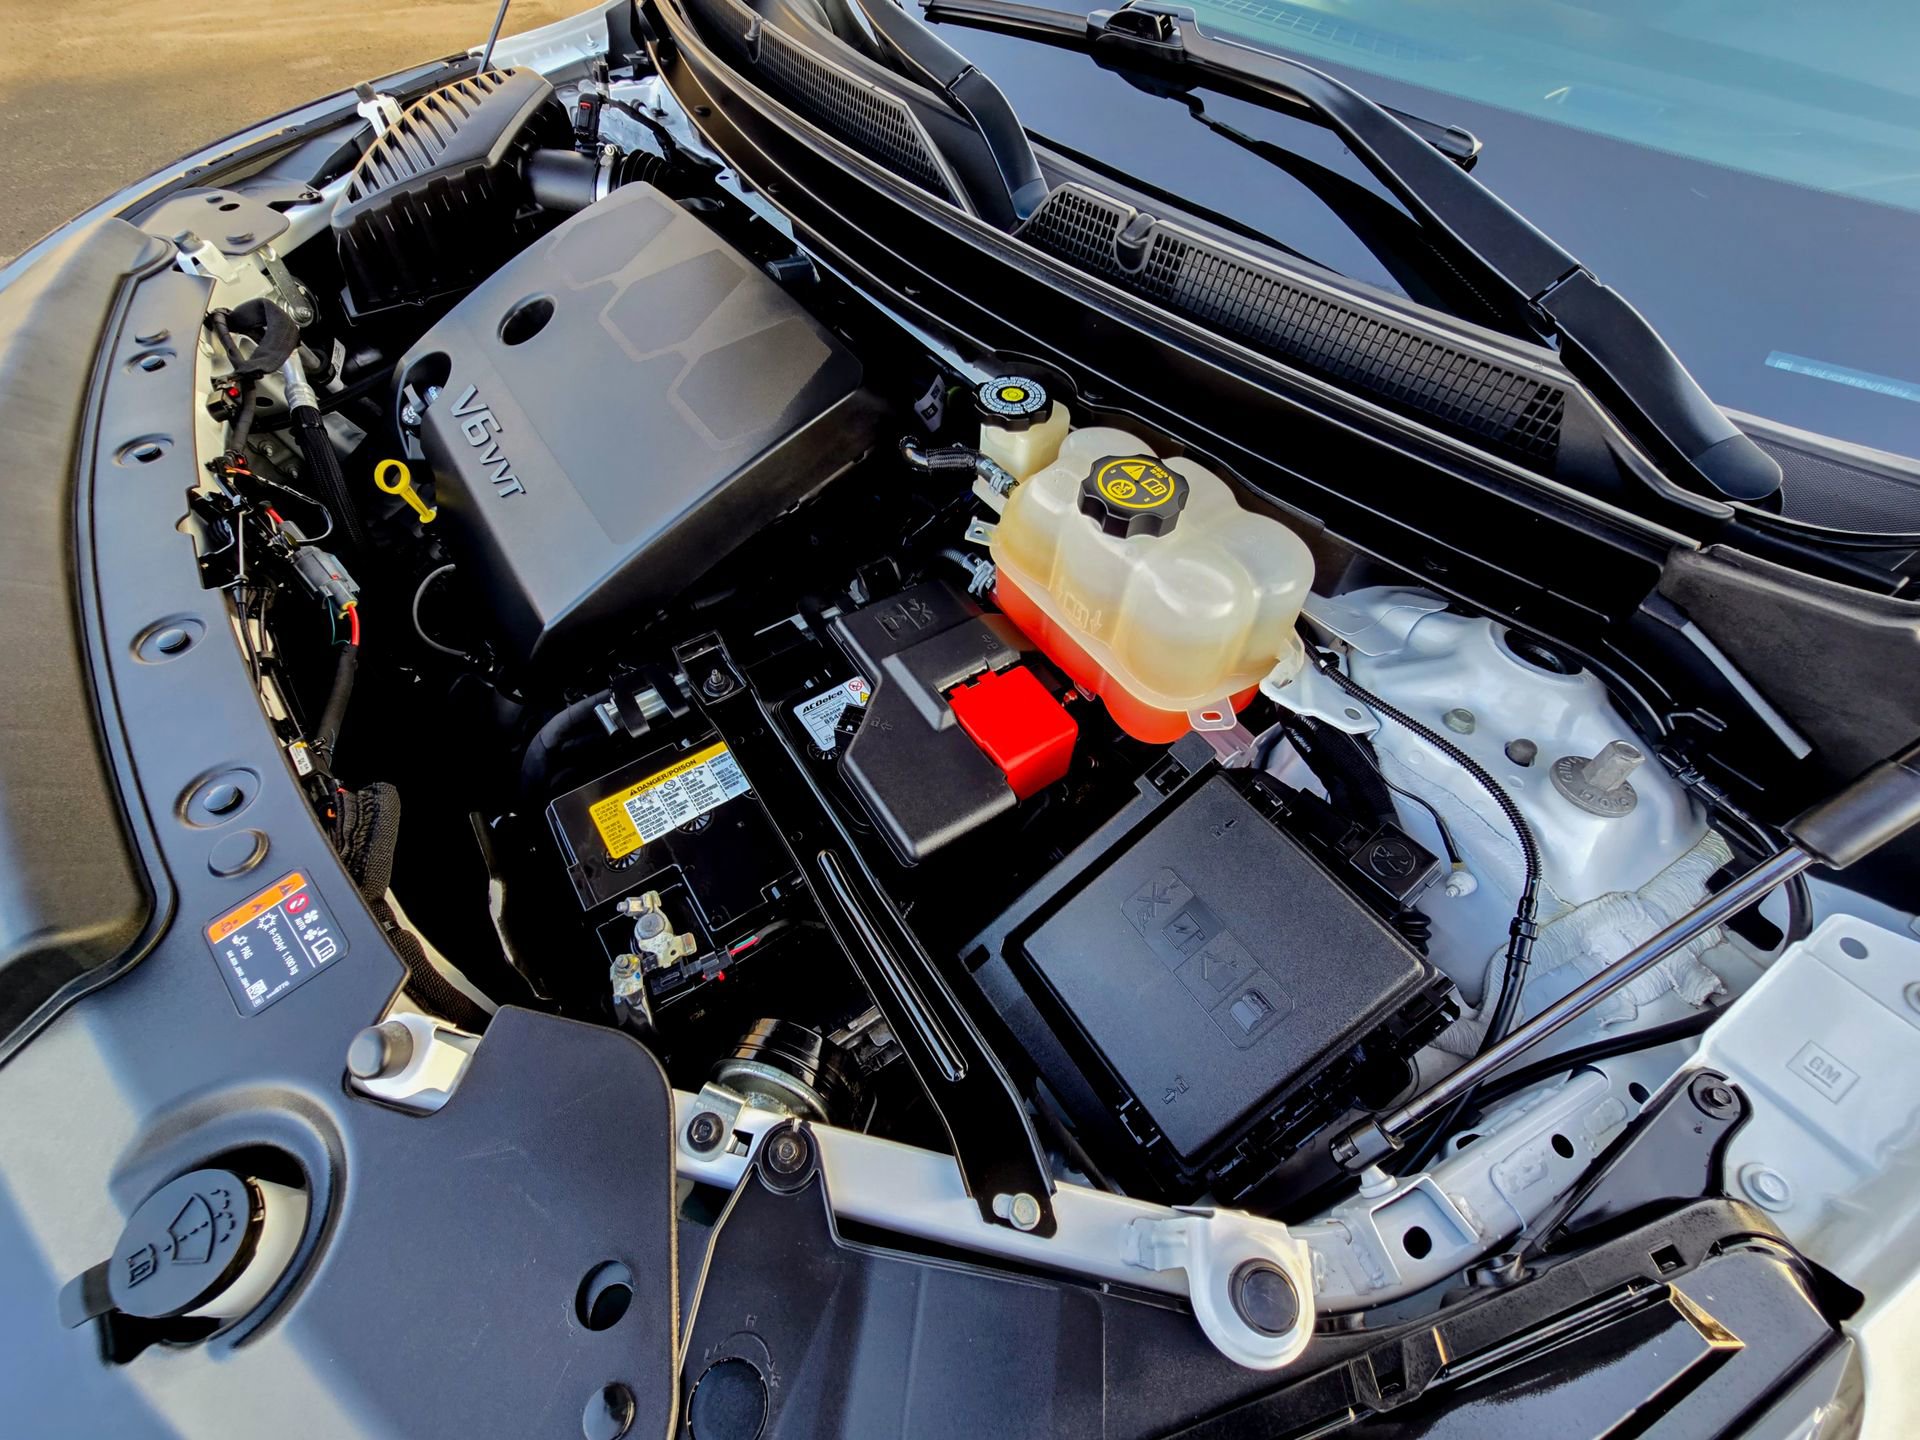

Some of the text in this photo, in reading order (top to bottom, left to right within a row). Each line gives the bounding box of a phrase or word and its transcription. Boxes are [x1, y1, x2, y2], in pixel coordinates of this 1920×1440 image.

[451, 384, 526, 498] V6 VVT
[803, 690, 843, 713] ACDelco
[637, 759, 697, 792] DANGER/POISON
[1808, 1056, 1842, 1086] GM
